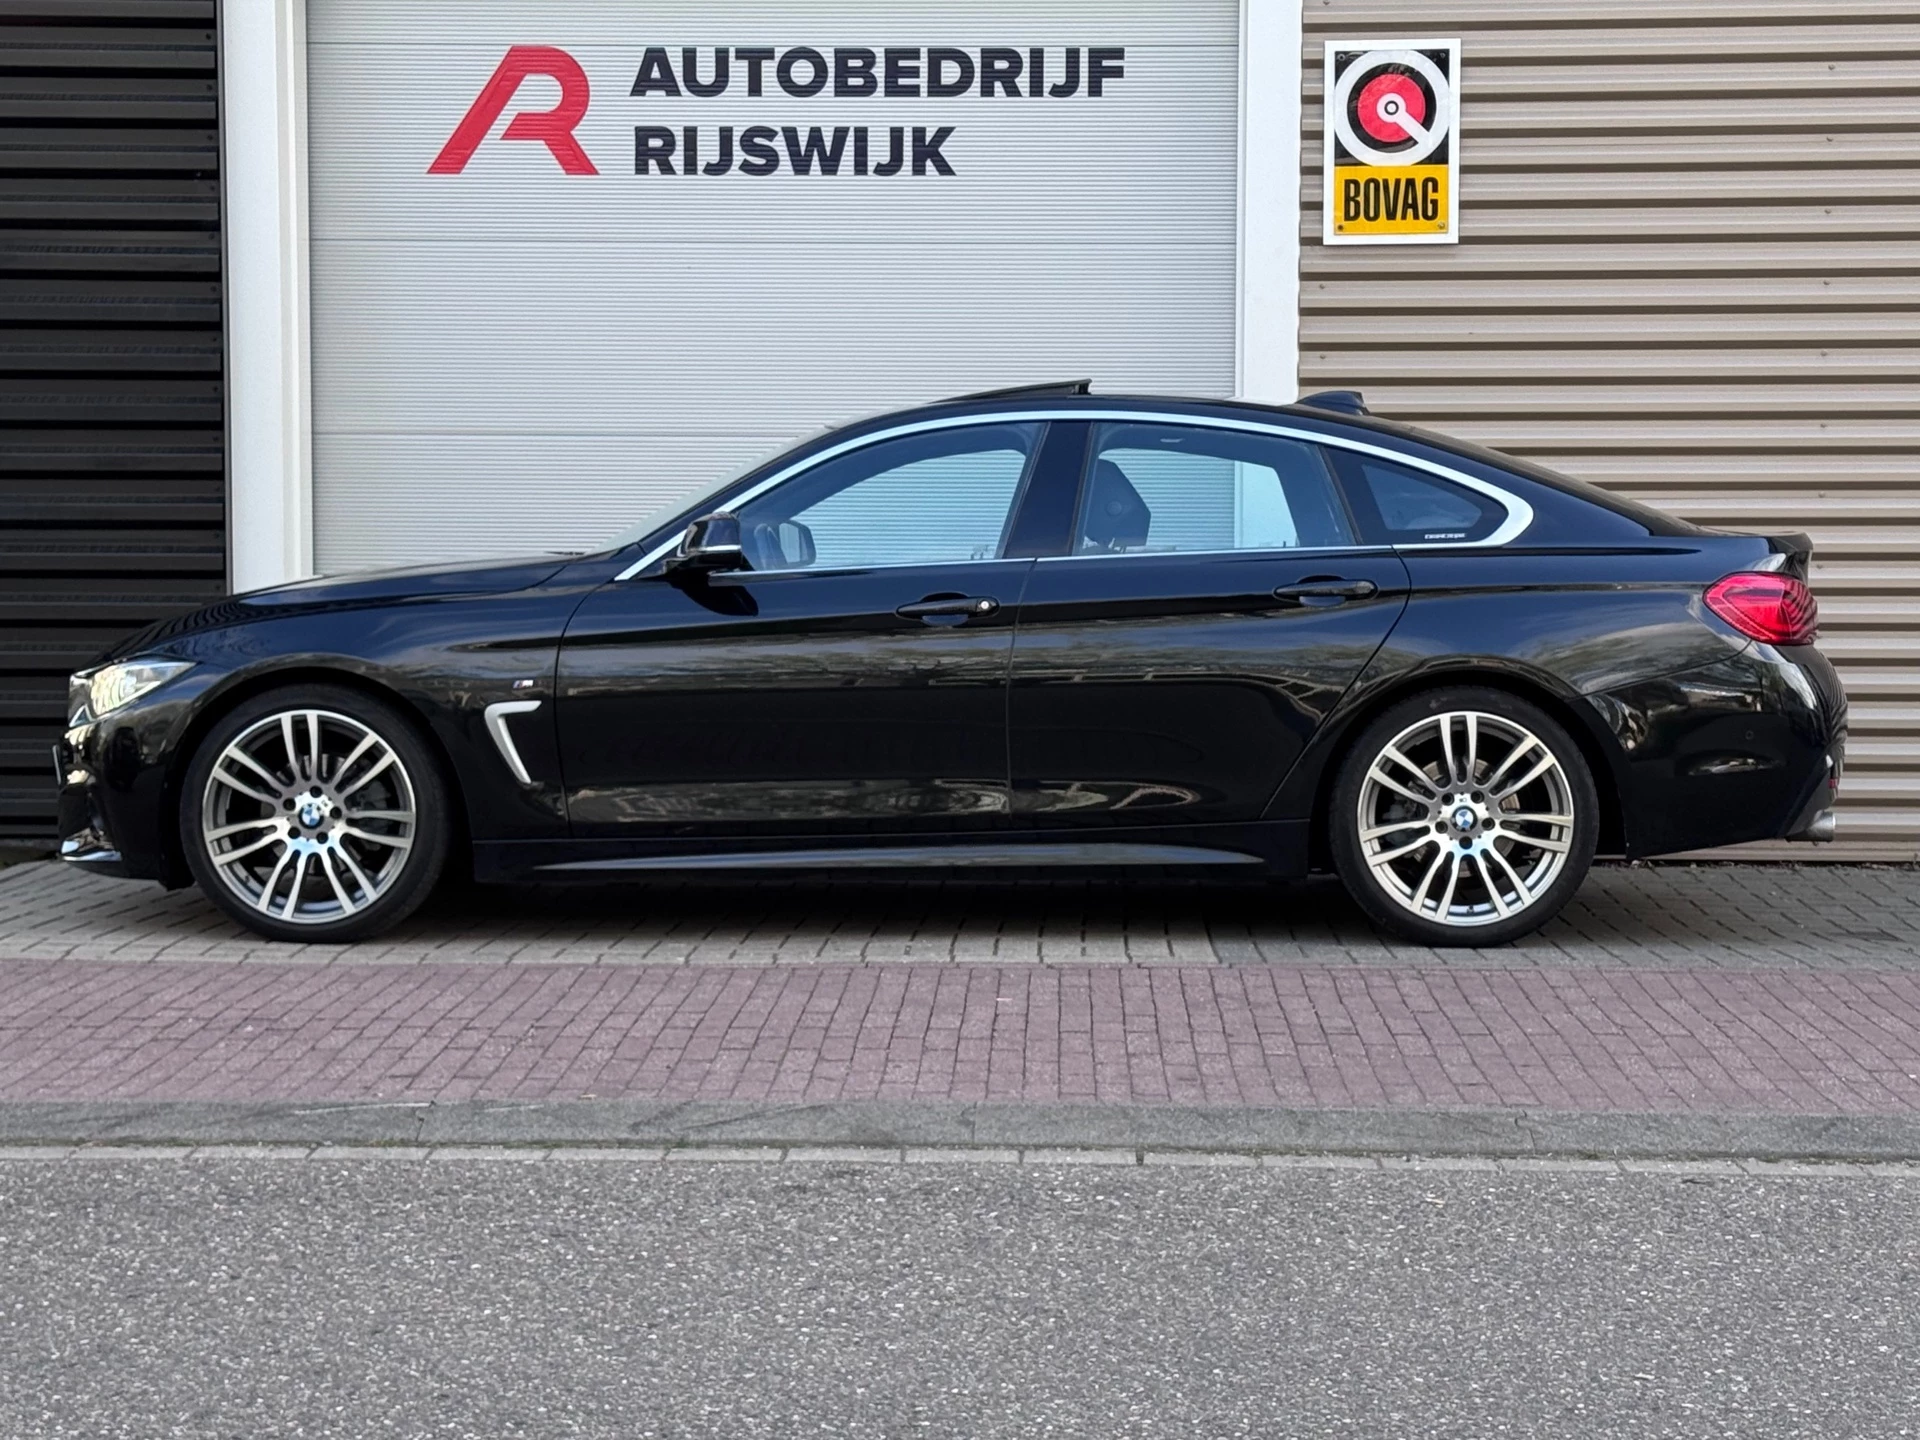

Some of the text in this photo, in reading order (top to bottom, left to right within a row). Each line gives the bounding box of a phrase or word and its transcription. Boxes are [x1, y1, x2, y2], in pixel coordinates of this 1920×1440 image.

[630, 47, 1124, 98] AUTOBEDRIJF
[635, 126, 955, 176] RIJSWIJK
[1344, 177, 1439, 222] BOVAG
